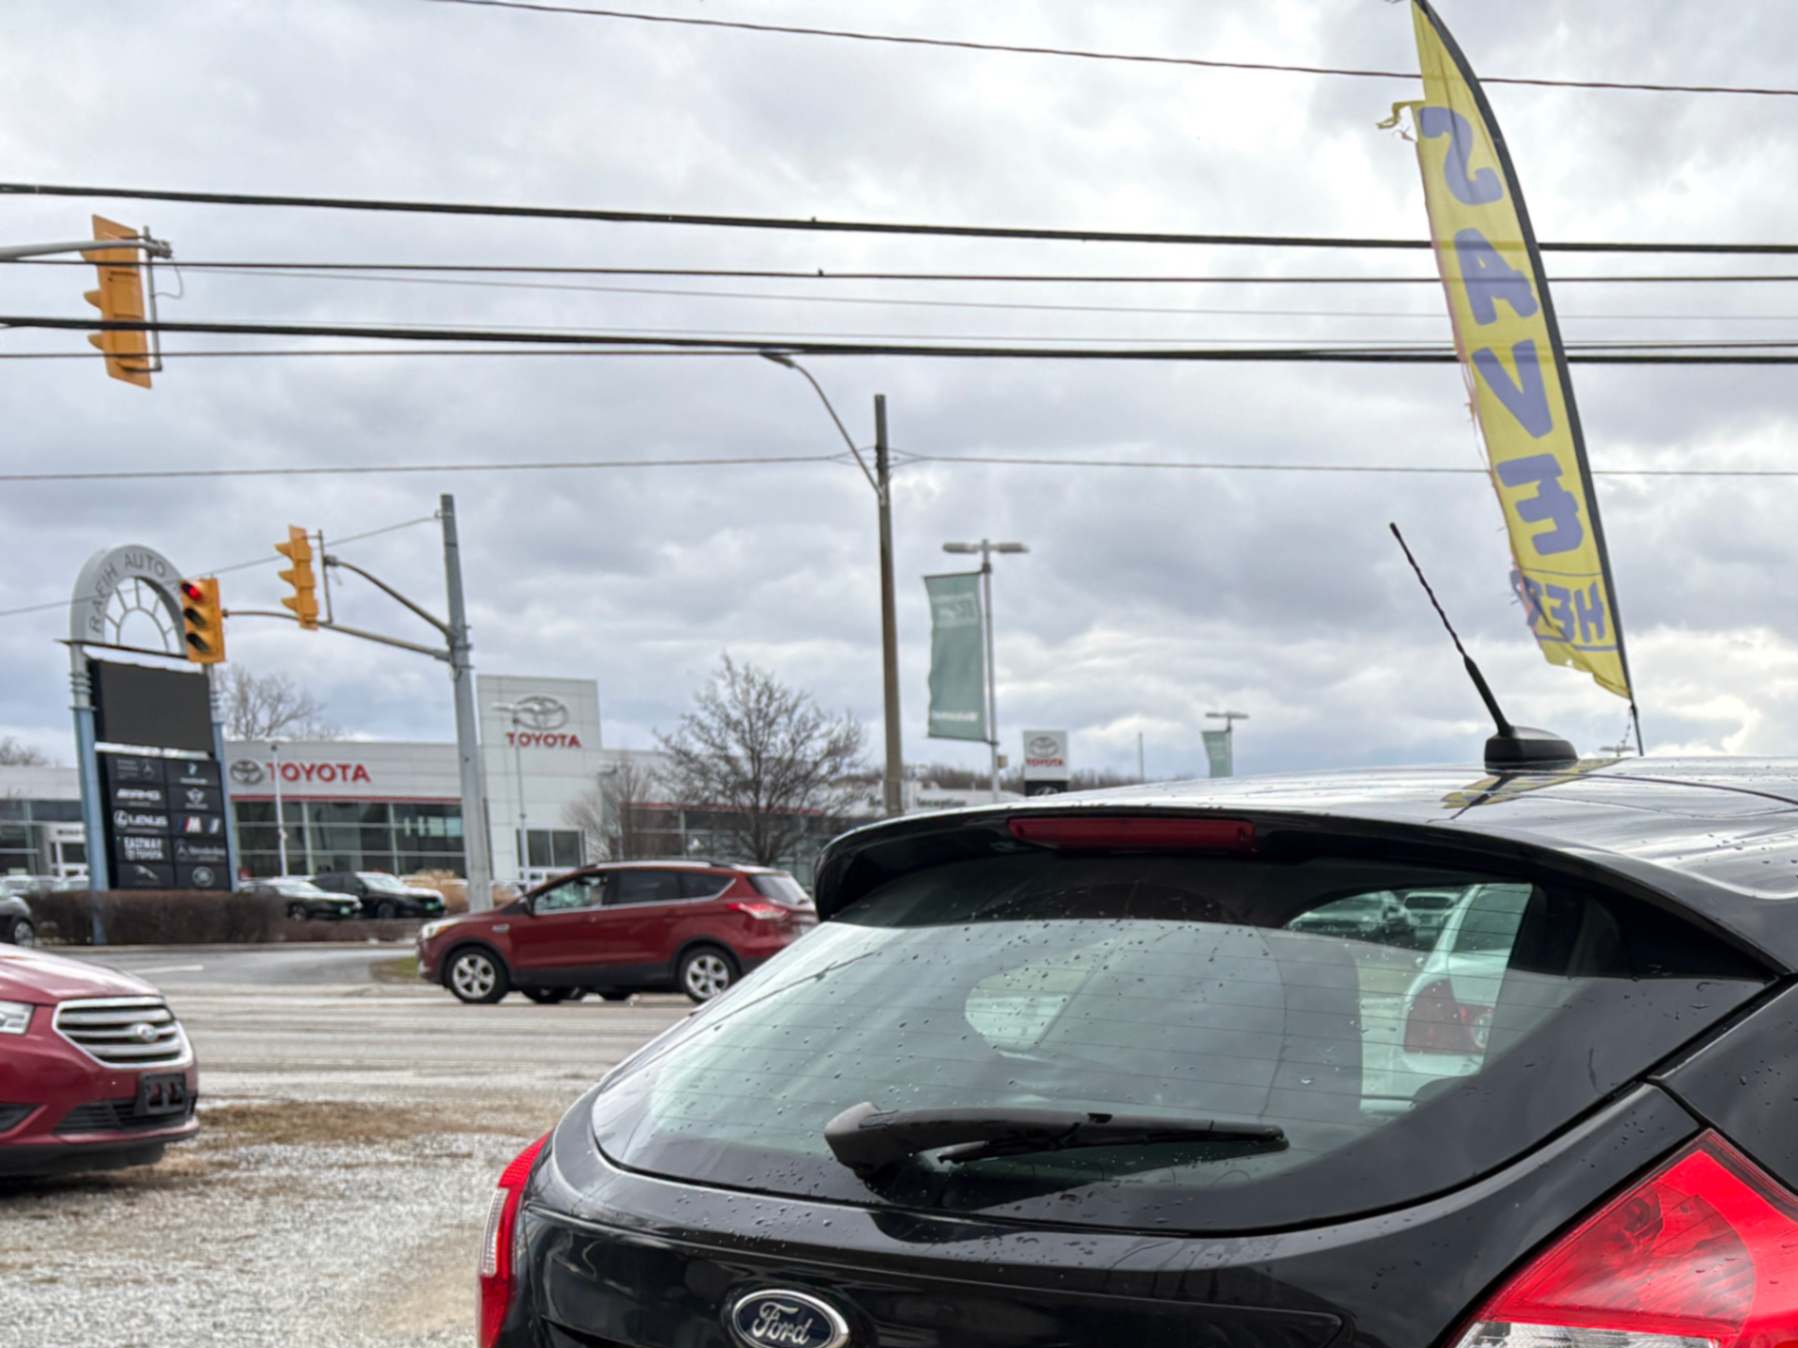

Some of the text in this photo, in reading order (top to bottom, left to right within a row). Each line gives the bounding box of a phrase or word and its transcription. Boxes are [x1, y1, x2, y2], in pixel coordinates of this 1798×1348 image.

[124, 552, 167, 578] AUTO
[505, 731, 581, 749] TOYOTA
[266, 763, 371, 783] TOYOTA
[1025, 758, 1064, 768] TOYOTA
[752, 1301, 814, 1345] Ford
